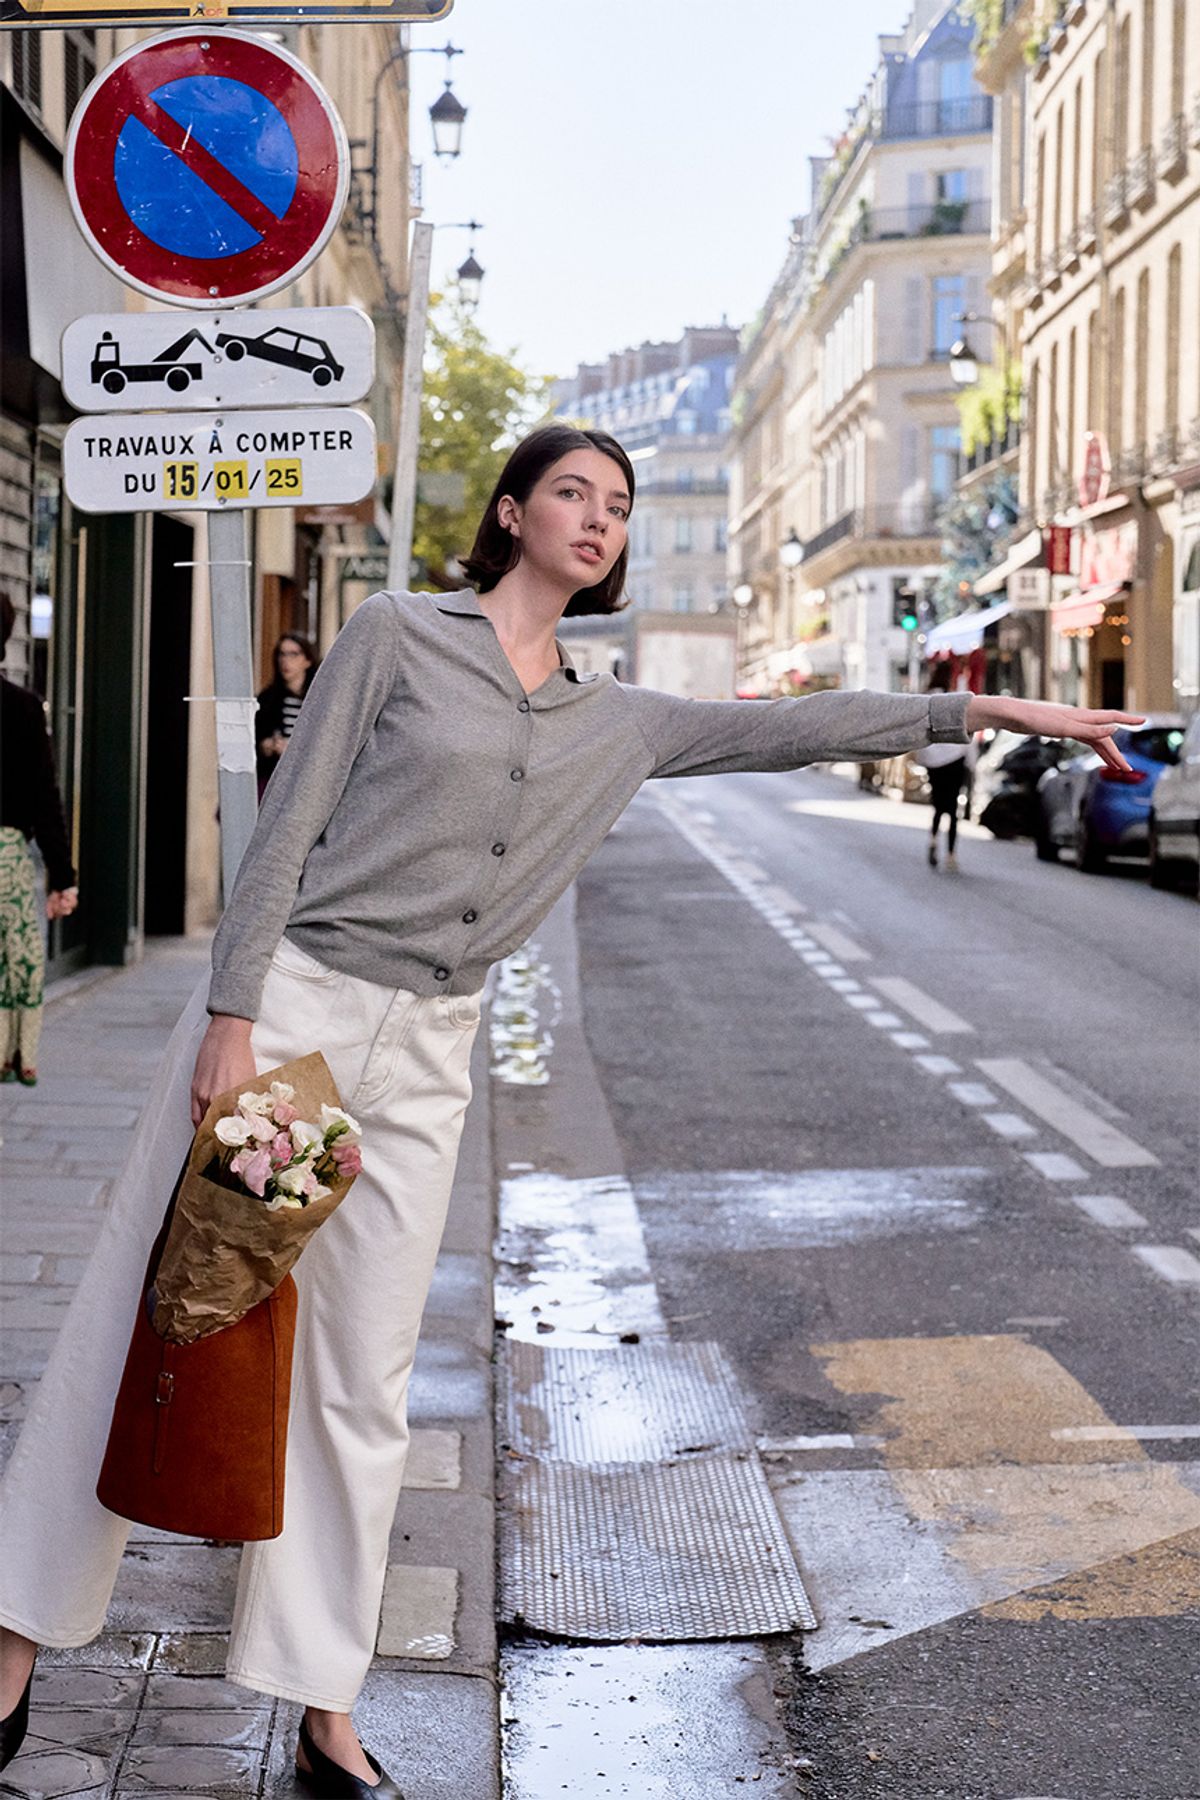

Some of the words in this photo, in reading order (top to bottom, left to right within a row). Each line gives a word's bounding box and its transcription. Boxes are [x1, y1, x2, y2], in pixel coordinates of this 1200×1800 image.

[84, 434, 195, 458] TRAVAUX
[208, 430, 223, 453] À
[236, 430, 353, 453] COMPTER
[124, 473, 156, 494] DU
